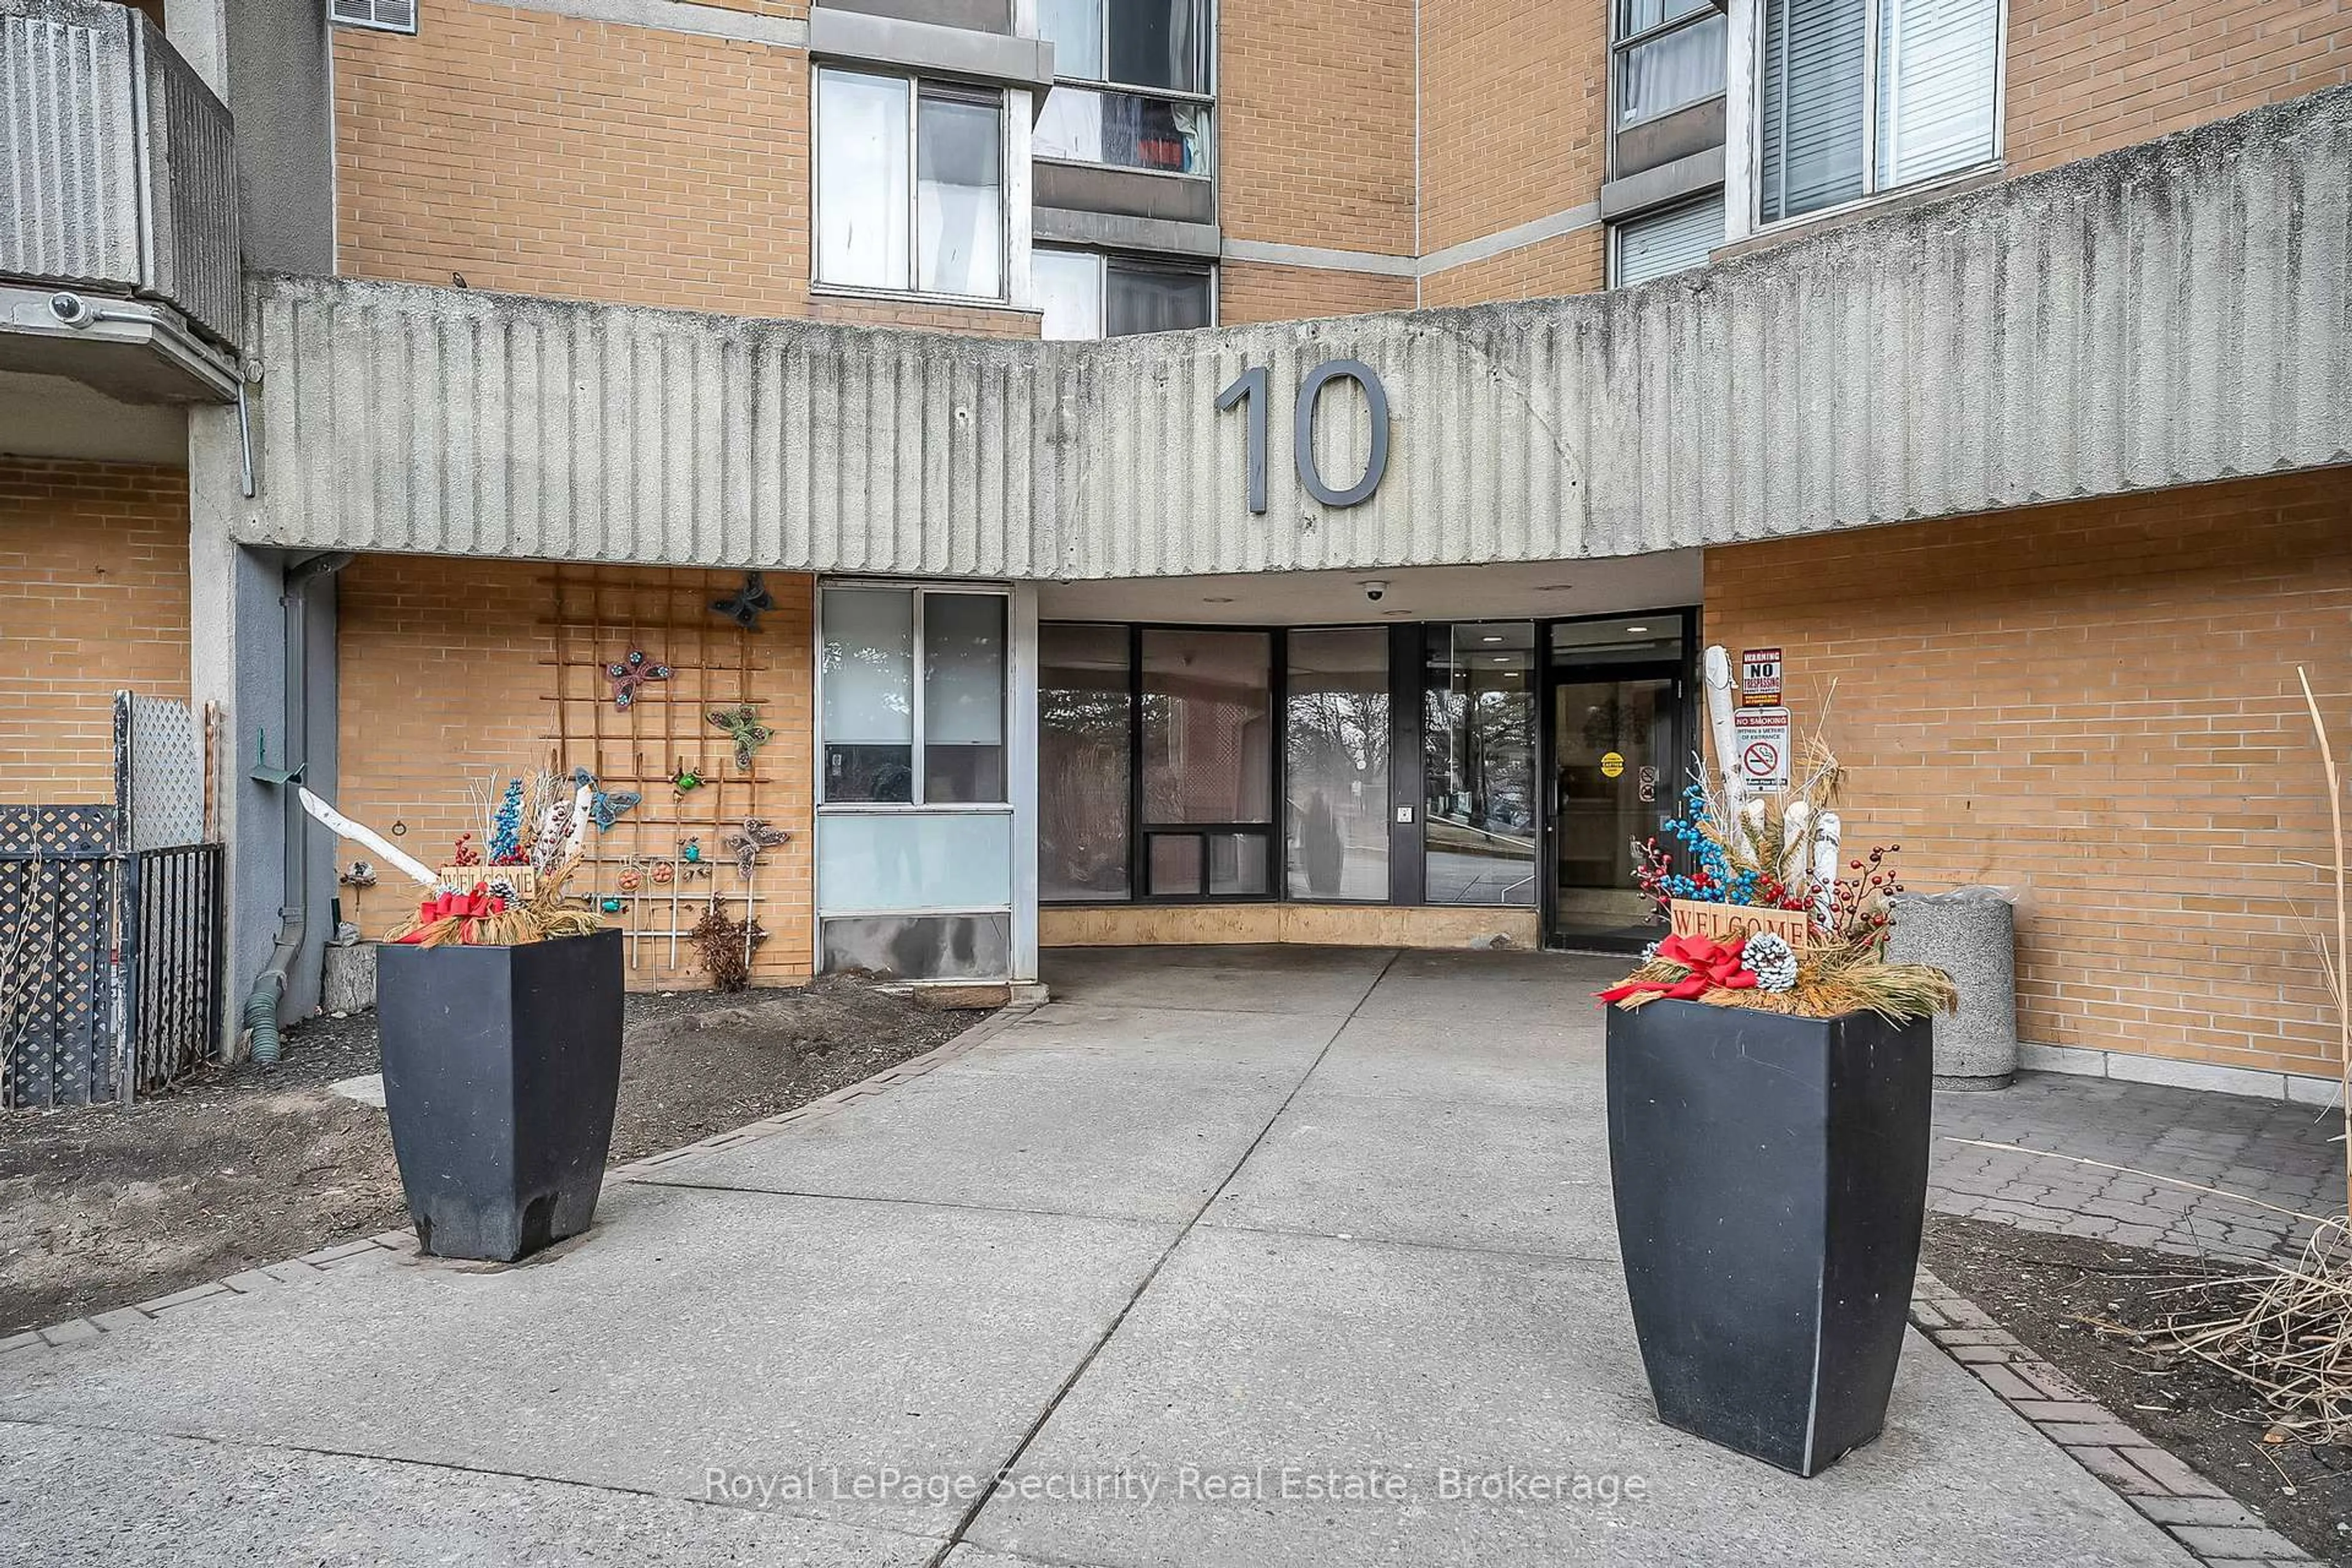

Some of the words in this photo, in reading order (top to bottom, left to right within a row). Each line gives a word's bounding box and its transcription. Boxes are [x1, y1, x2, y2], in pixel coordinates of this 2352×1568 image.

[1215, 360, 1390, 514] 10
[1744, 652, 1779, 662] WARNING
[1751, 664, 1773, 677] NO
